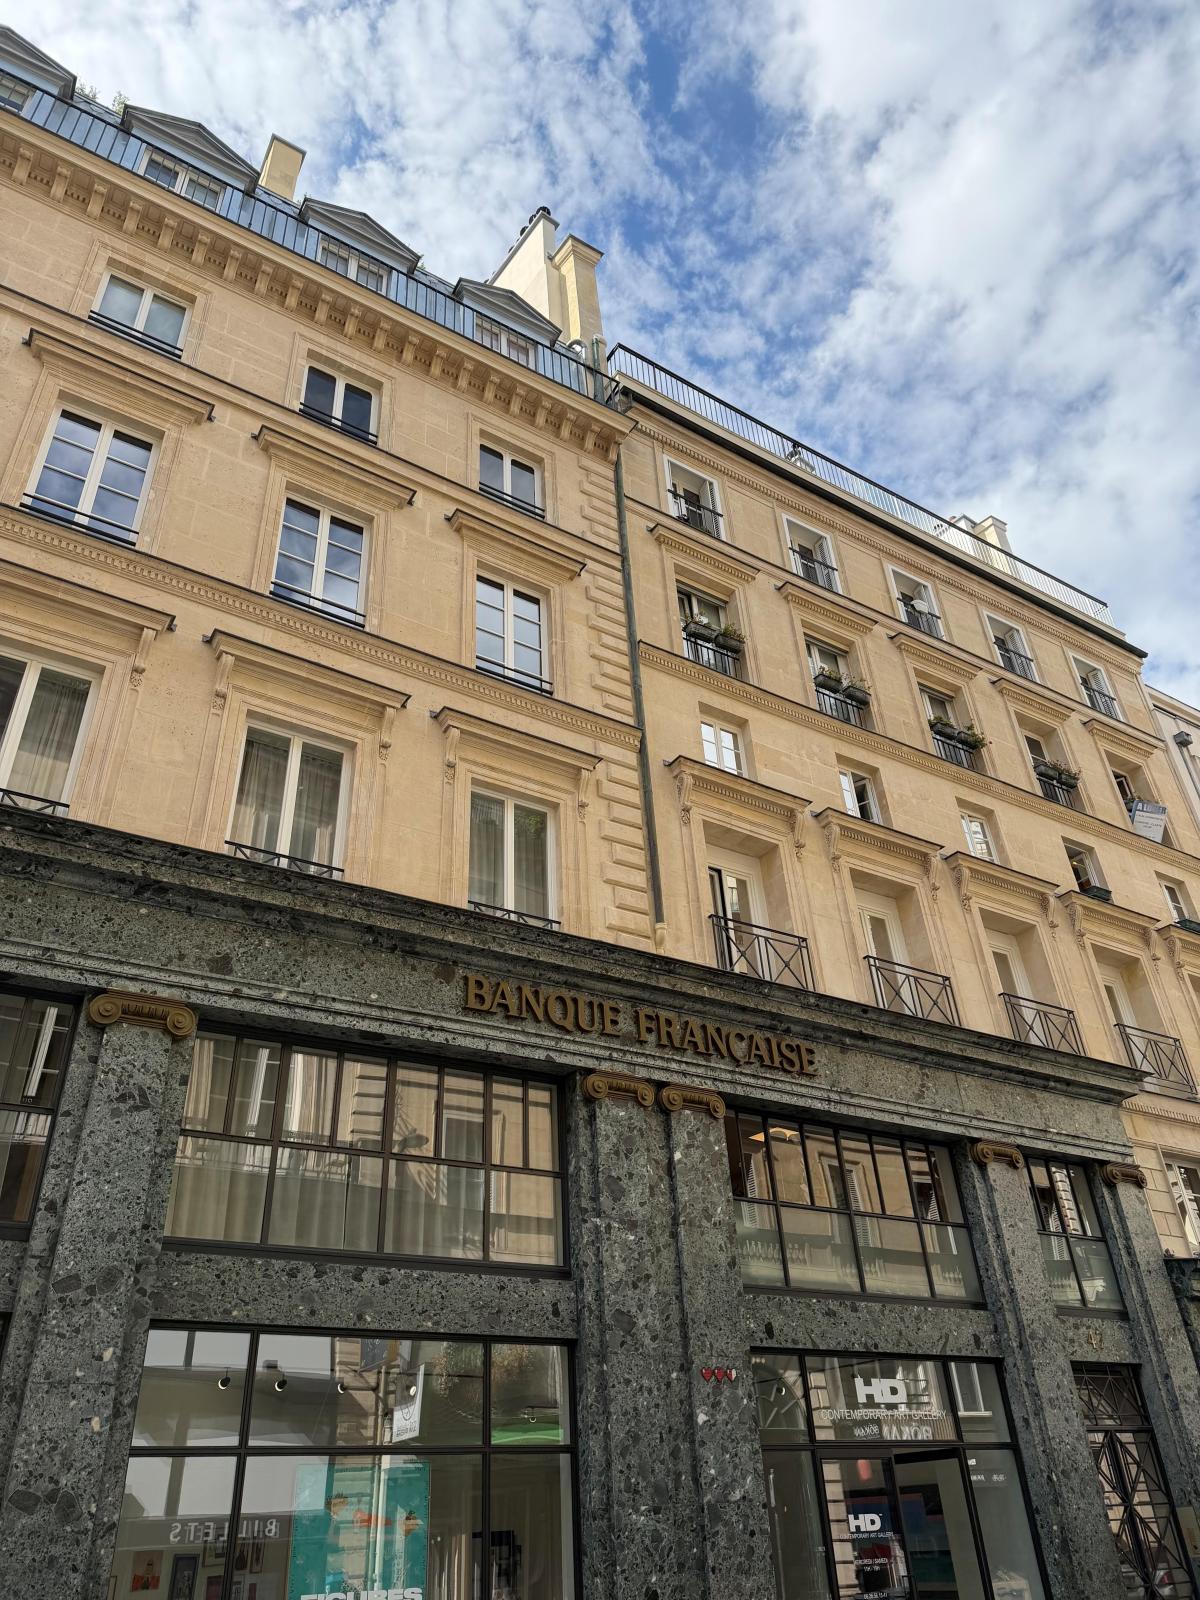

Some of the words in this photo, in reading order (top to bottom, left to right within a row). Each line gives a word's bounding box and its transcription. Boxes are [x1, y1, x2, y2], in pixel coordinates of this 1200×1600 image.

[464, 974, 621, 1036] BANQUE
[636, 1008, 821, 1077] FRANÇAISE
[854, 1377, 908, 1404] HD
[820, 1409, 891, 1421] CONTEMPORARY
[892, 1409, 910, 1421] ART
[912, 1409, 947, 1421] GALLERY
